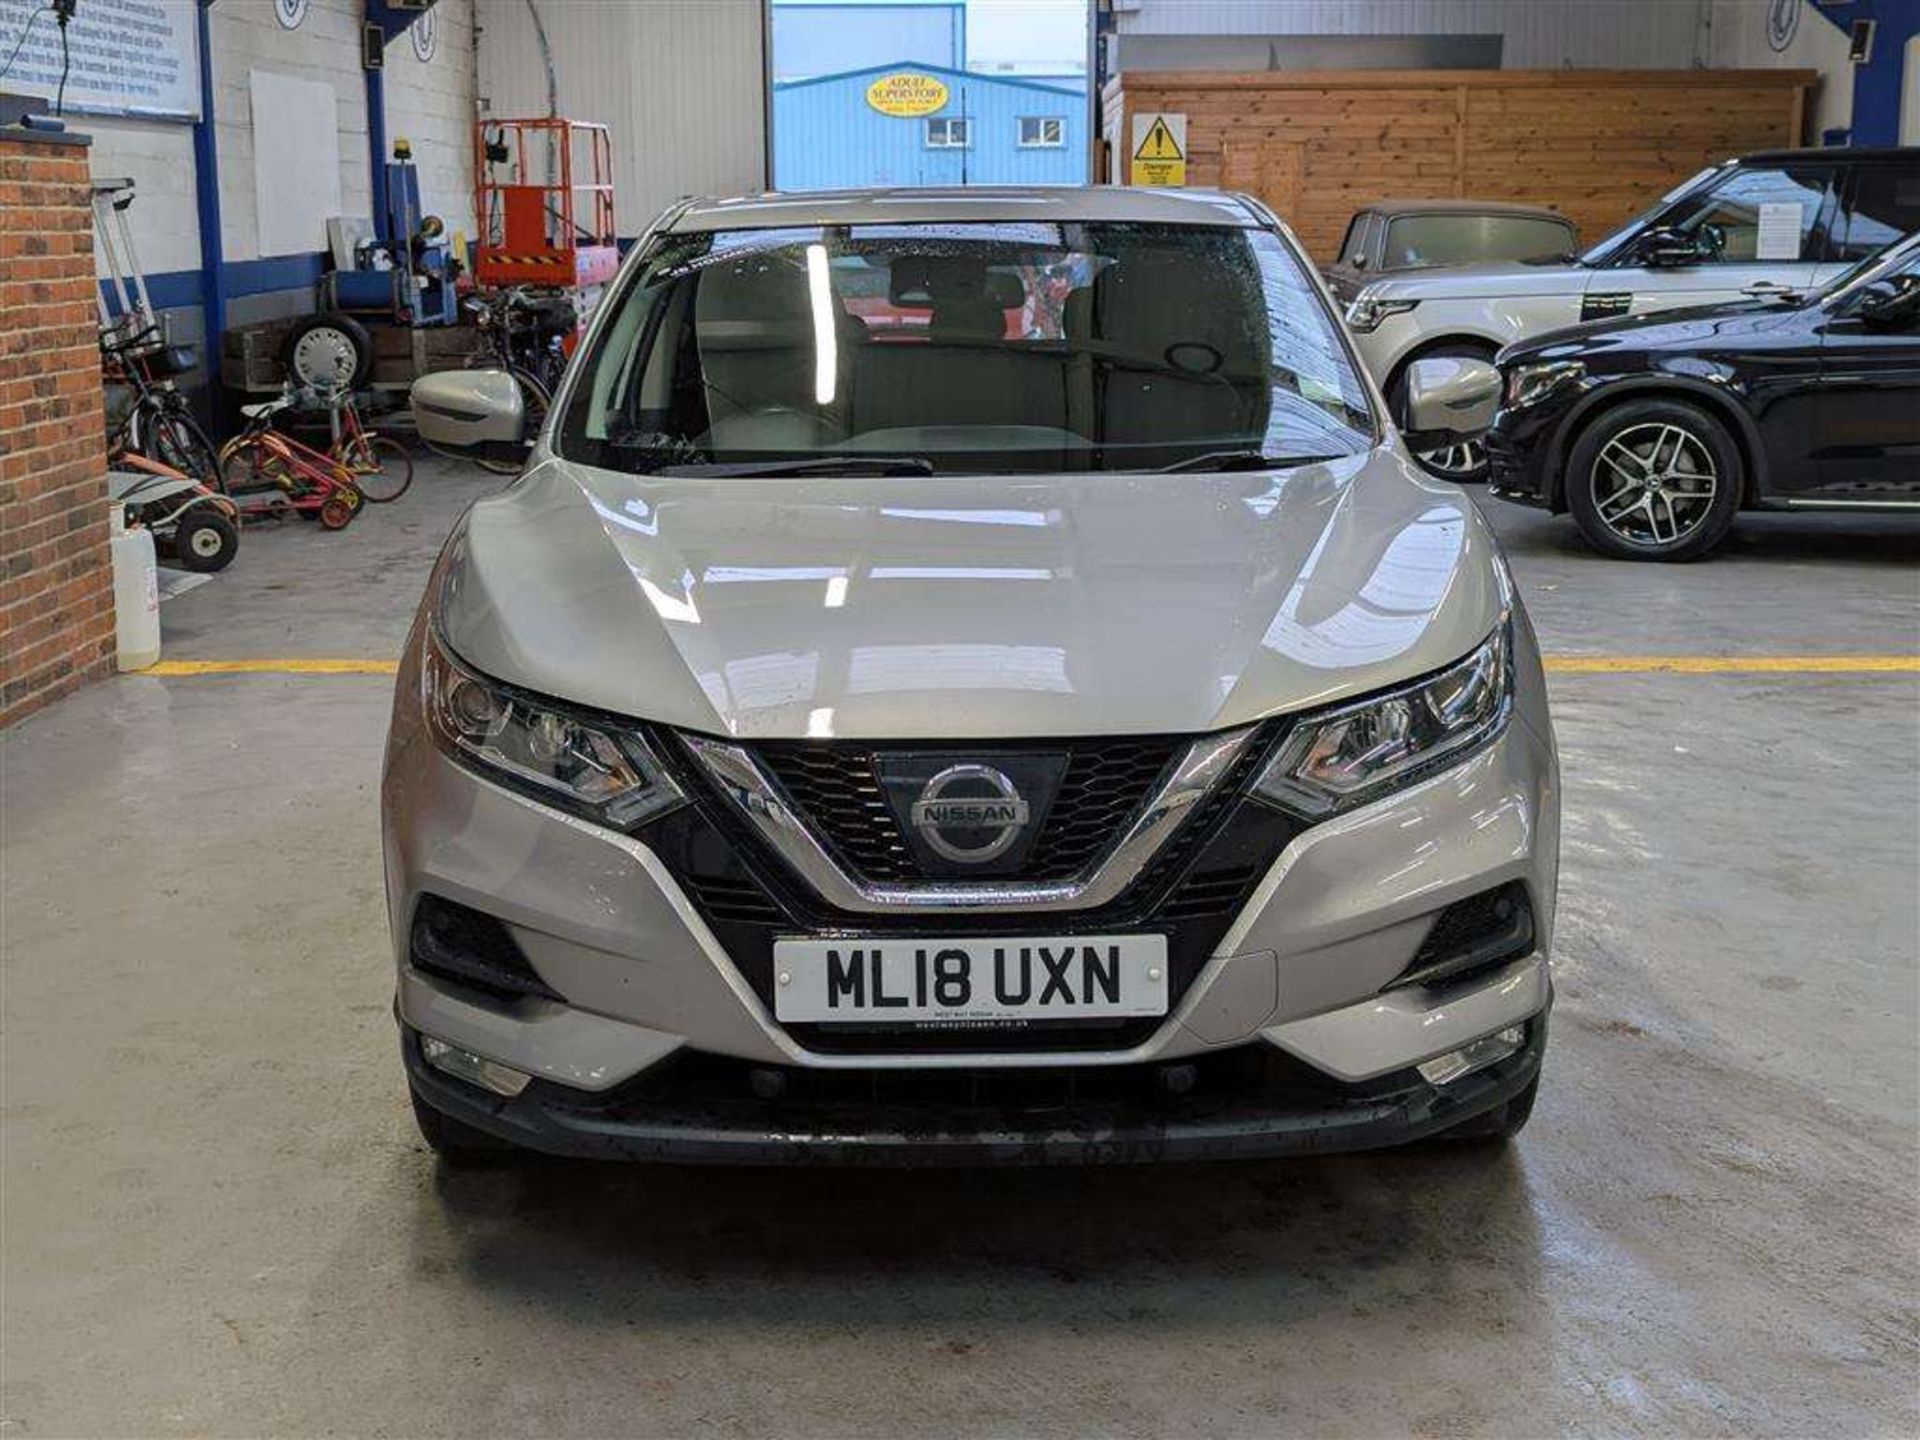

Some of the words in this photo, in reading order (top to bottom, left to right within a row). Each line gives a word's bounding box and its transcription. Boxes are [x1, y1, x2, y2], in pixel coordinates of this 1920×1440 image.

[887, 77, 928, 87] ADULT
[872, 87, 944, 98] SUPERSTORE
[924, 806, 1016, 821] NISSAN
[826, 949, 972, 1008] ML18
[994, 945, 1121, 1006] UXN
